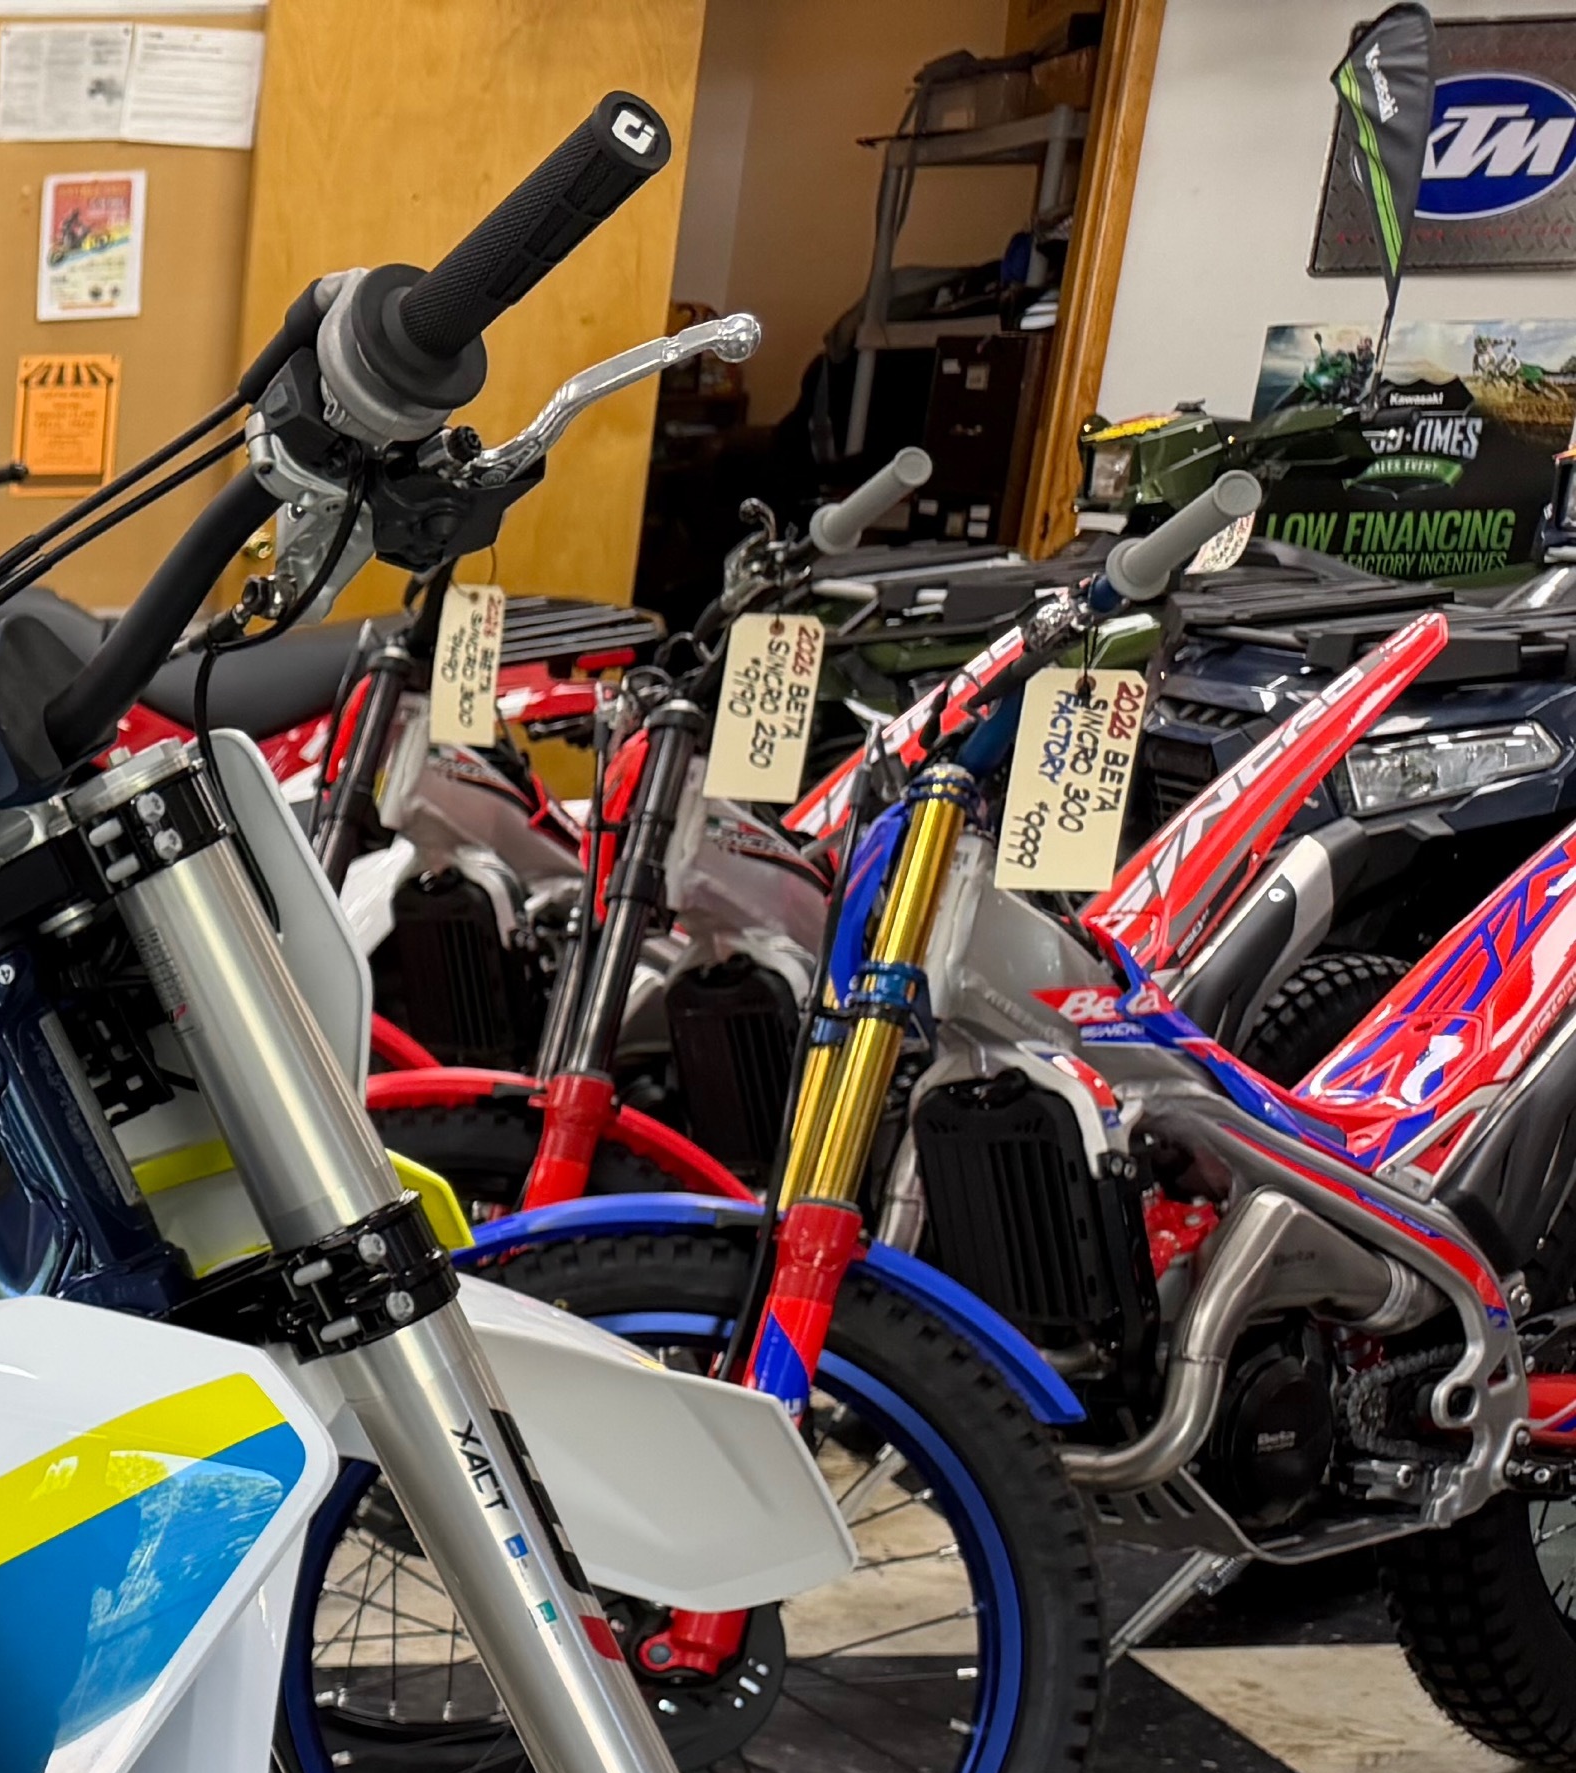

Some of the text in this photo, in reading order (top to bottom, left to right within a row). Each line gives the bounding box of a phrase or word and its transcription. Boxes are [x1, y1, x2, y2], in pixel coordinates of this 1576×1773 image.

[1422, 104, 1576, 178] KTM
[1388, 391, 1445, 407] Kawasaki
[1403, 459, 1439, 475] EVENT
[1265, 511, 1338, 552] LOW
[1343, 508, 1516, 552] FINANCING
[749, 638, 791, 770] SINCRO 250
[781, 682, 810, 741] BETA
[1038, 688, 1079, 785] FACTORY
[1057, 698, 1109, 834] SINCRO 300
[1093, 680, 1146, 813] 2026 BETA
[448, 1419, 511, 1513] XACT
